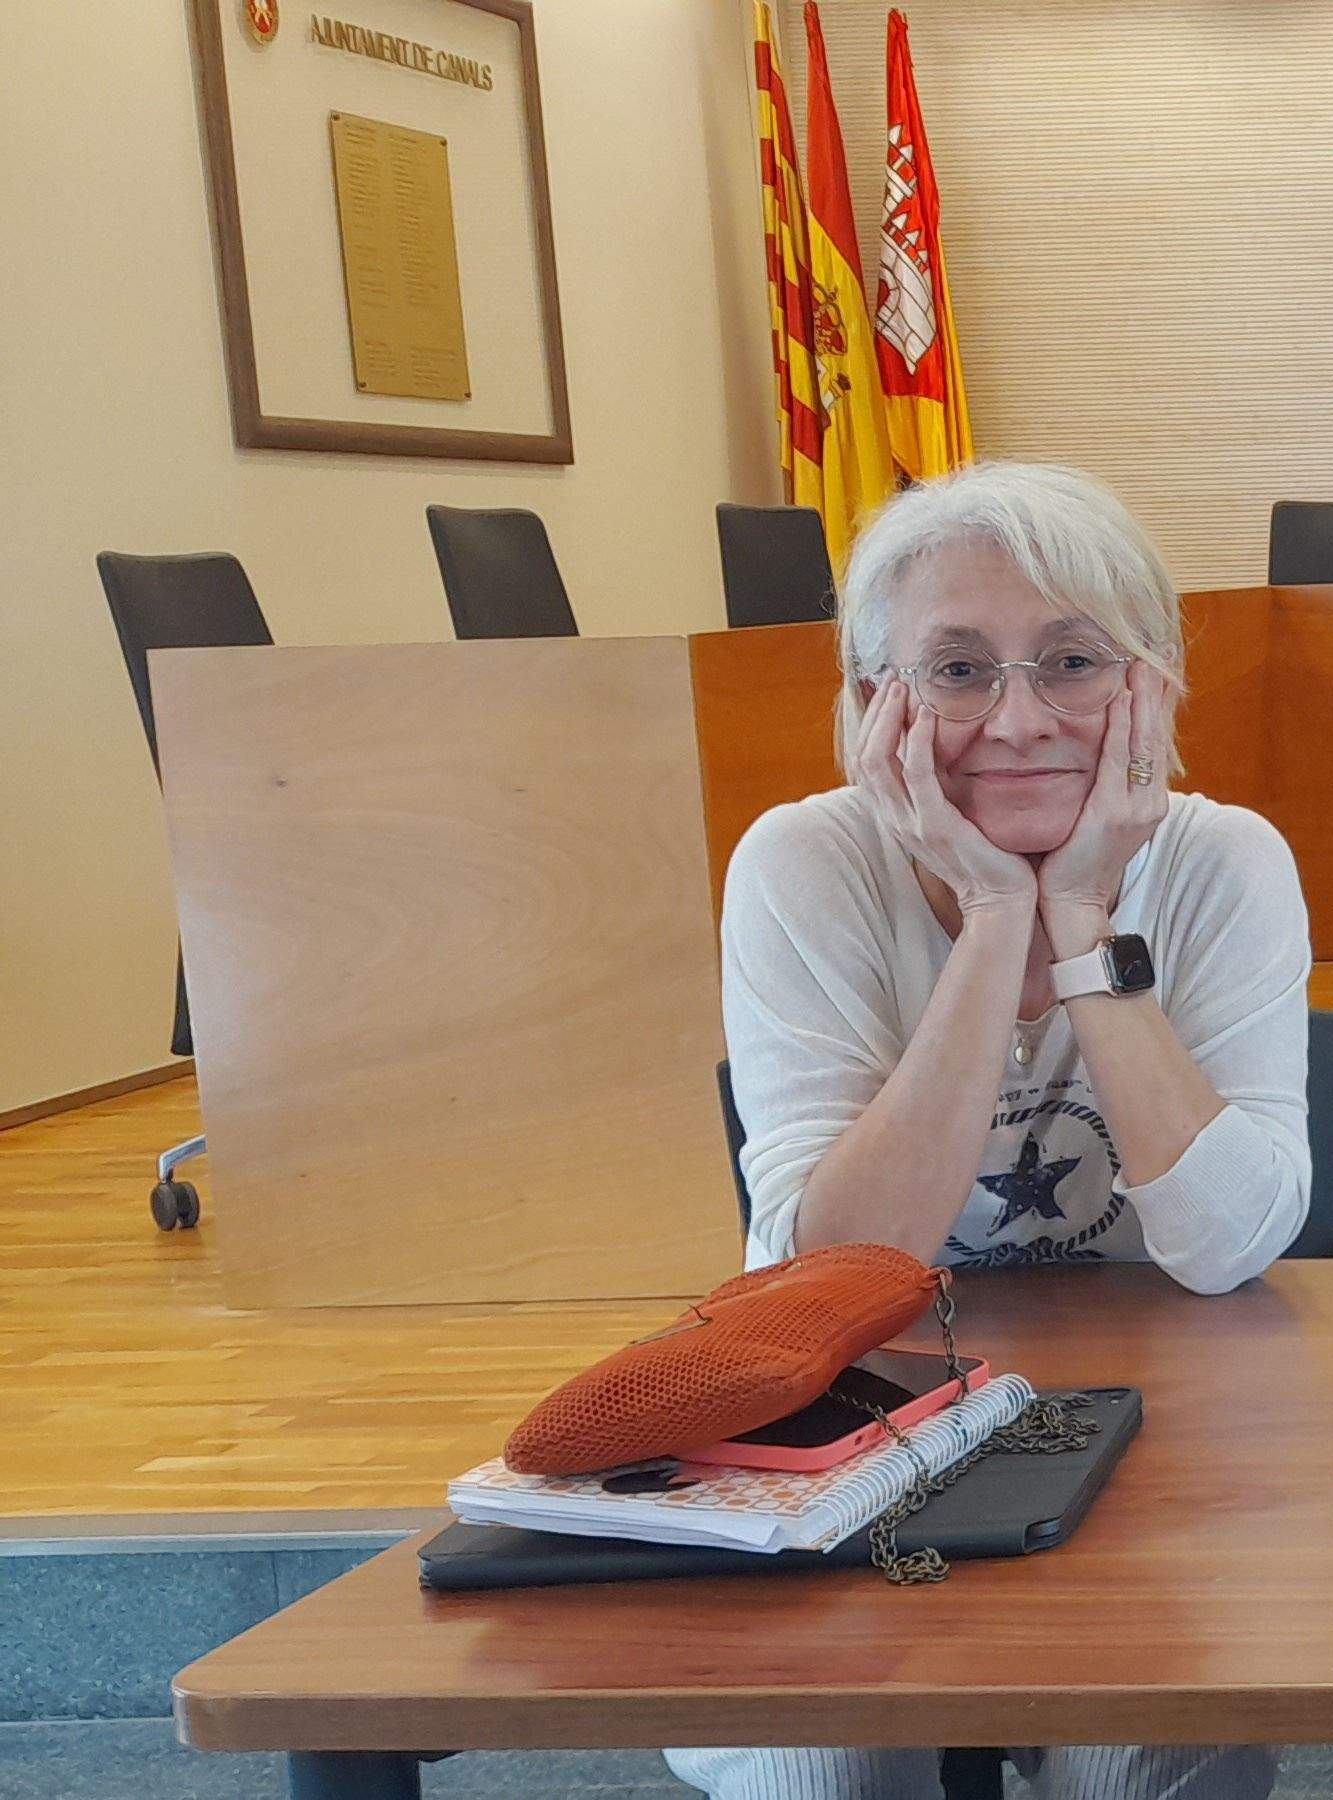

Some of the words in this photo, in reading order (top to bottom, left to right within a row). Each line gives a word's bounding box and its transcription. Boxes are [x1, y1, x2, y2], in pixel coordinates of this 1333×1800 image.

[310, 13, 410, 66] AJUNTAMENT
[413, 42, 434, 73] DE
[436, 50, 493, 91] CANALS
